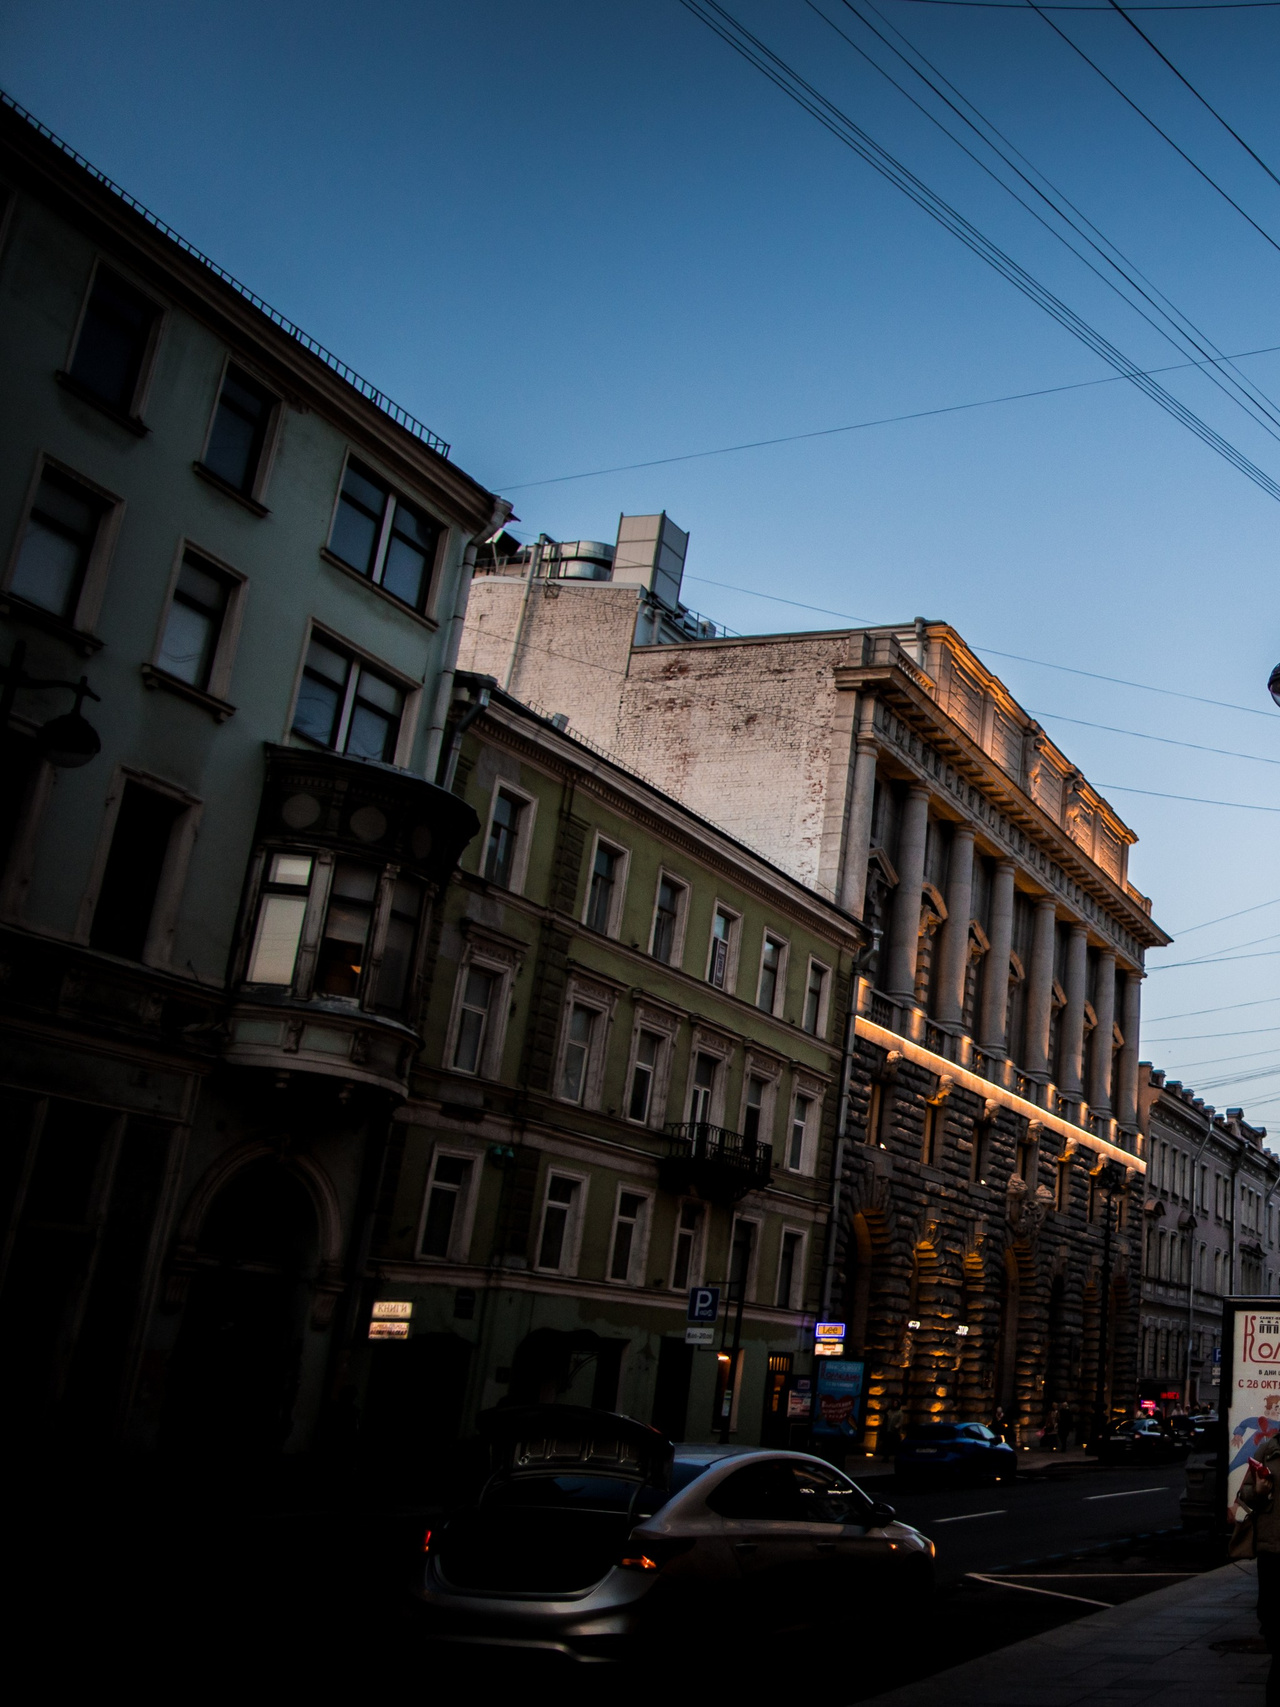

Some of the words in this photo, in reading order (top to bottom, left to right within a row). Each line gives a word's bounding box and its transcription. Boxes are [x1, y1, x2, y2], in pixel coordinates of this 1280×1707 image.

[694, 1290, 712, 1316] P
[377, 1304, 407, 1313] КНИГИ
[822, 1326, 838, 1334] Lee
[1238, 1379, 1244, 1388] С
[1247, 1379, 1259, 1388] 28
